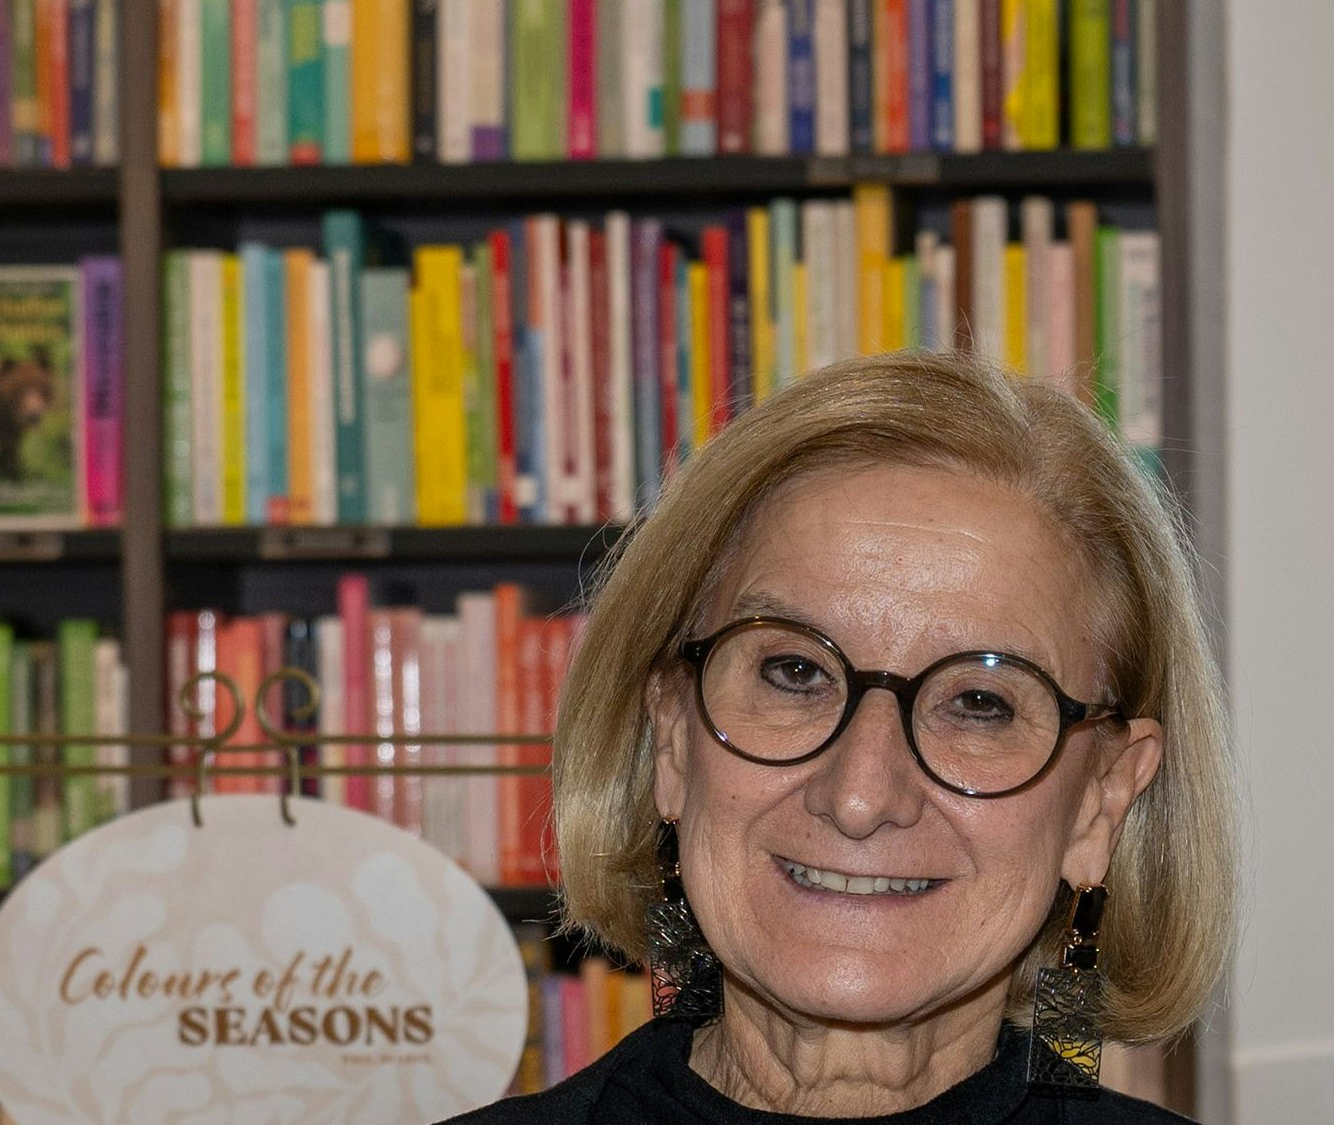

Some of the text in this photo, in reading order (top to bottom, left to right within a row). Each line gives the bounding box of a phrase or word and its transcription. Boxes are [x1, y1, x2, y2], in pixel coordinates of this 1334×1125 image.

[59, 946, 388, 1013] Colours of the
[178, 1003, 434, 1047] SEASONS
